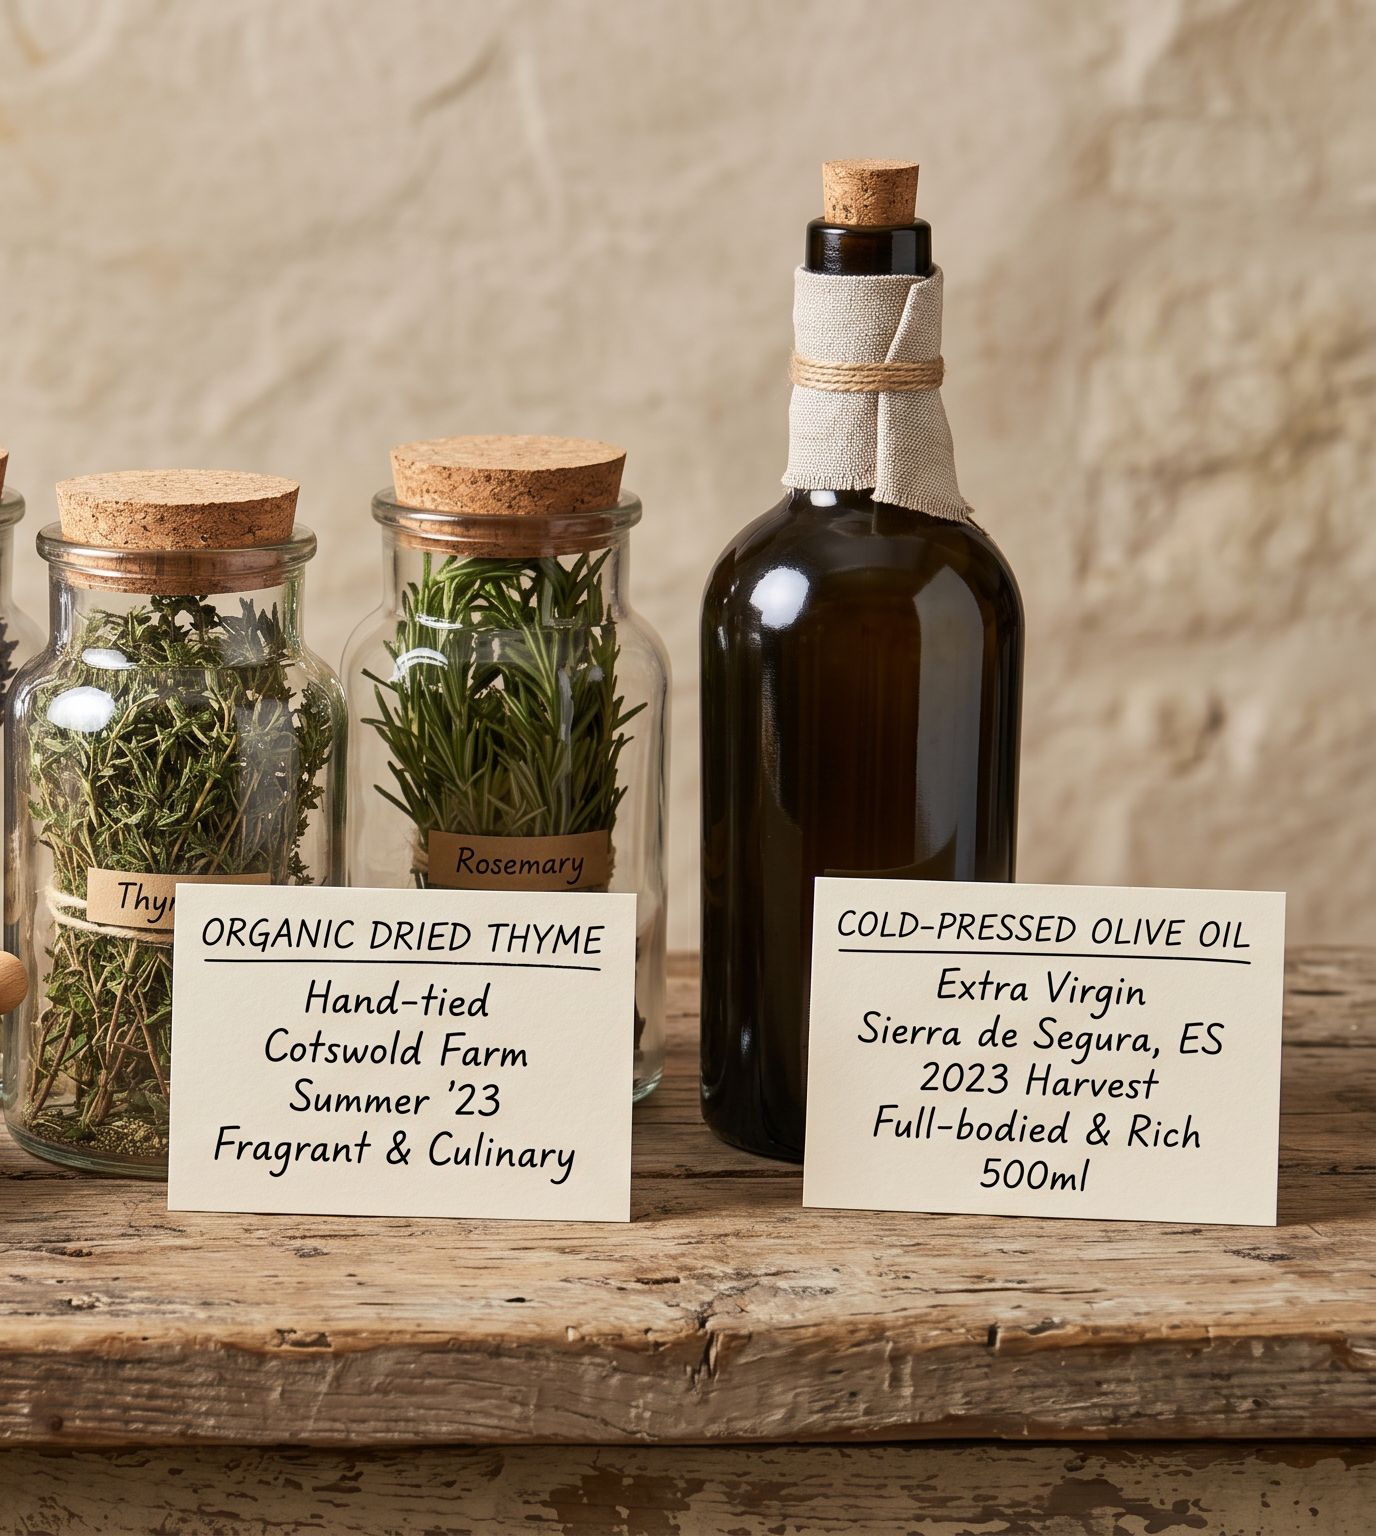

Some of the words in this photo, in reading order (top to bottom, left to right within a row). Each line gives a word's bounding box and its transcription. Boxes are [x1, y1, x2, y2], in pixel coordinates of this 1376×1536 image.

[455, 846, 585, 886] Rosemary
[117, 881, 175, 924] Thy
[202, 917, 355, 953] ORGANIC
[369, 920, 472, 952] DRIED
[487, 923, 606, 955] THYME
[837, 909, 1077, 943] COLD-PRESSED
[1091, 917, 1186, 947] OLIVE
[1199, 920, 1251, 949] OIL
[304, 979, 491, 1018] Hand-tied
[936, 967, 1029, 1002] Extra
[1047, 970, 1146, 1020] Virgin
[264, 1027, 424, 1066] Cotswold
[440, 1031, 528, 1068] Farm
[857, 1010, 962, 1046] Sierra
[977, 1014, 1018, 1048] de
[1032, 1016, 1160, 1065] Segura,
[1179, 1021, 1225, 1056] ES
[289, 1077, 431, 1116] Summer
[448, 1079, 500, 1117] '23
[919, 1061, 1009, 1095] 2023
[1025, 1062, 1160, 1100] Harvest
[873, 1104, 1071, 1144] Full-bodied
[1085, 1112, 1111, 1147] &
[1127, 1113, 1201, 1149] Rich
[214, 1125, 372, 1178] Fragrant
[385, 1129, 411, 1166] &
[428, 1130, 576, 1185] Culinary
[979, 1157, 1091, 1192] 500ml
